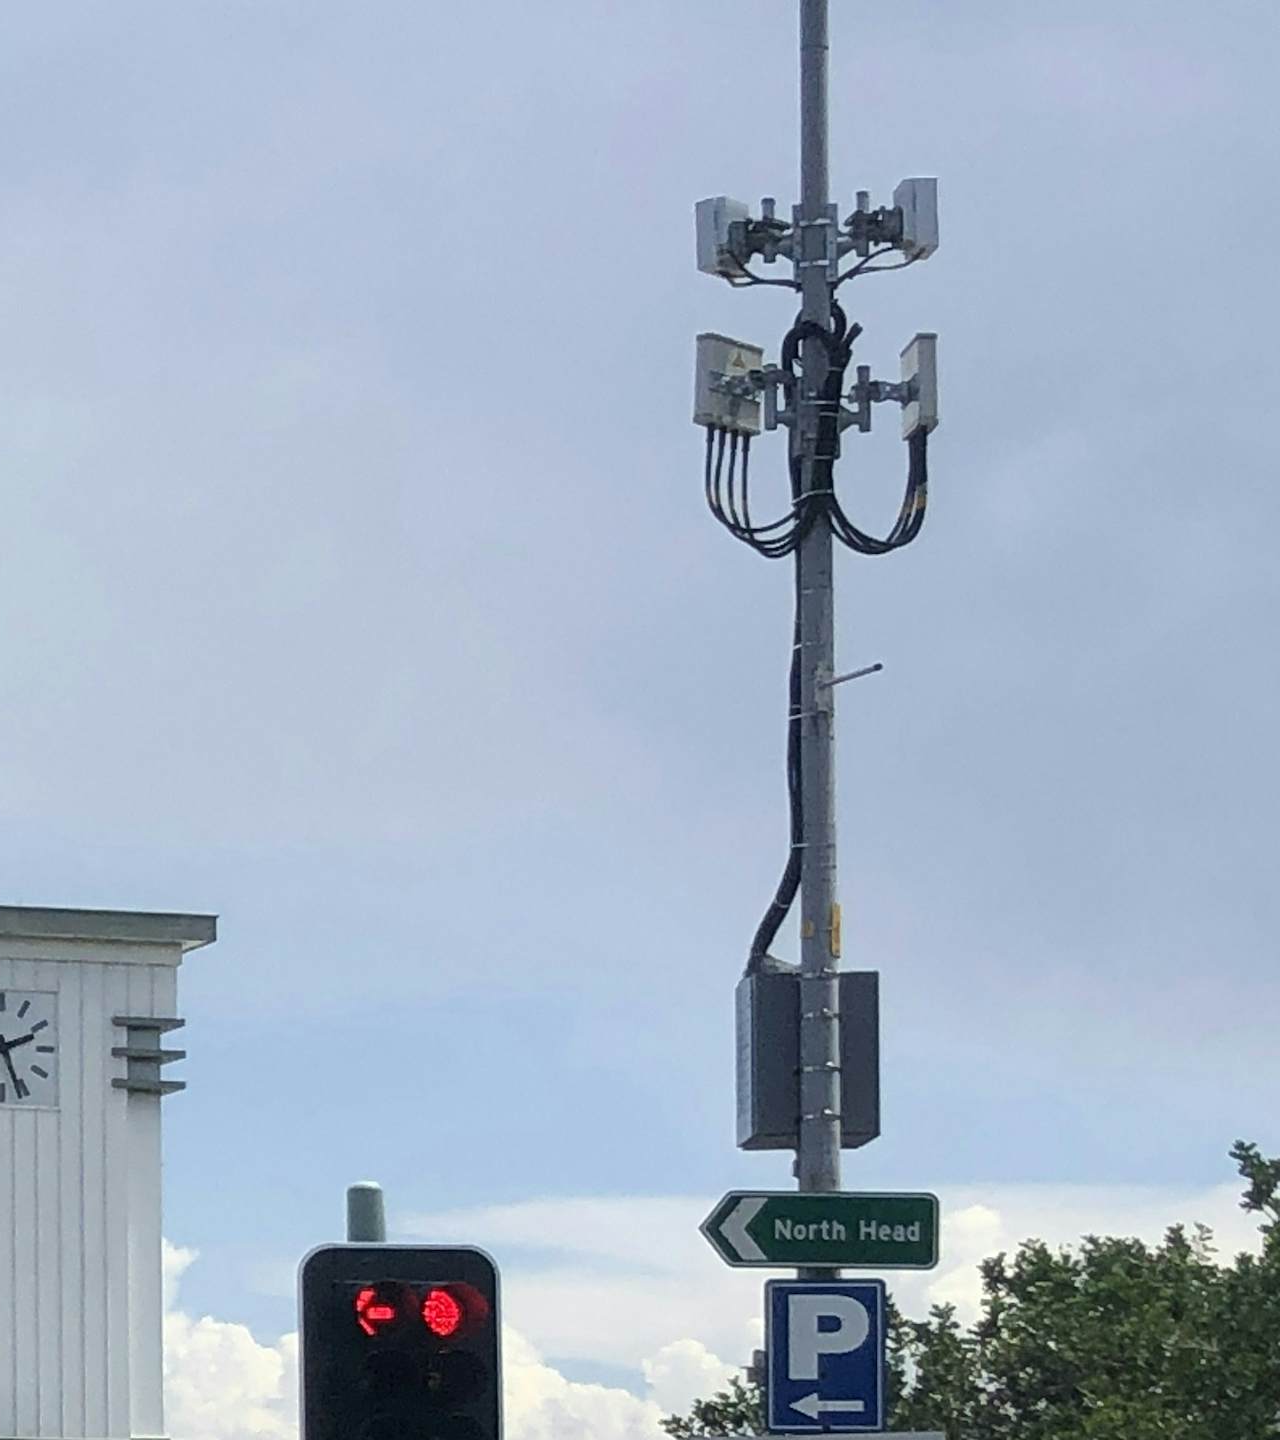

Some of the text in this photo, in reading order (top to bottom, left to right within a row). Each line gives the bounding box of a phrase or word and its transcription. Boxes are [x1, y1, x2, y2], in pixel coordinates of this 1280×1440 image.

[774, 1219, 920, 1242] North Head
[787, 1294, 870, 1380] P
